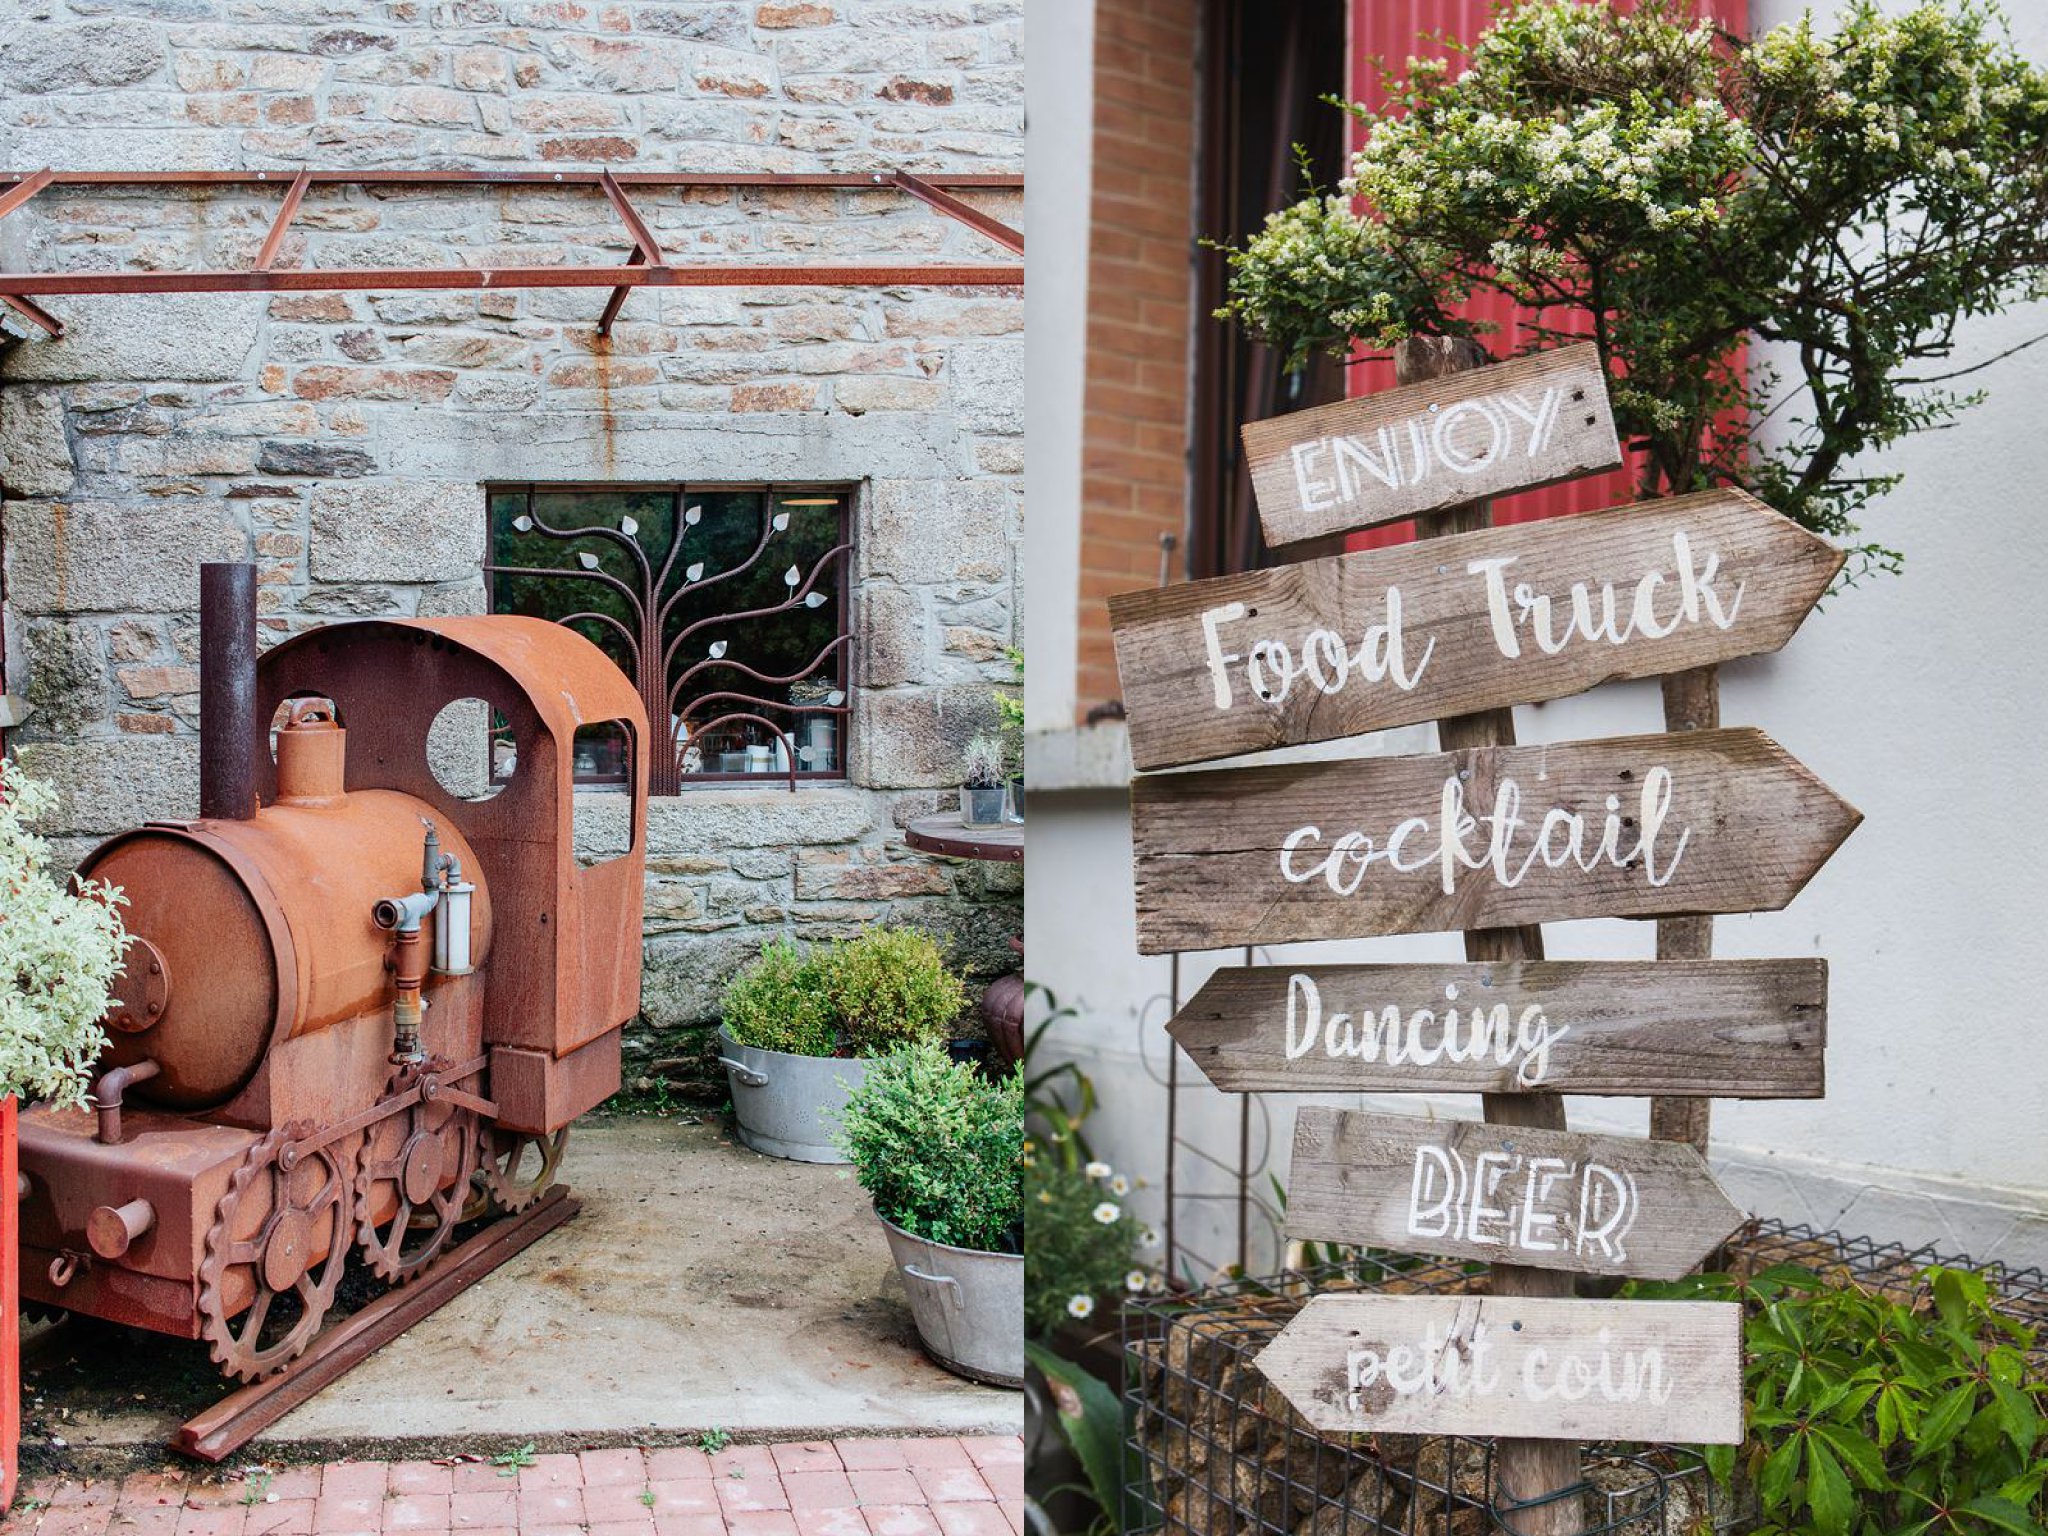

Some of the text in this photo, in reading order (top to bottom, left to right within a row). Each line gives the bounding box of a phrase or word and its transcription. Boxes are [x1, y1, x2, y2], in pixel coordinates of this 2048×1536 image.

[1290, 386, 1564, 512] ENJOY
[1200, 531, 1746, 710] Food Truck
[1279, 766, 1691, 896] cocktail
[1285, 973, 1571, 1087] Dancing
[1407, 1145, 1640, 1264] BEER
[1346, 1320, 1675, 1412] petit coin
